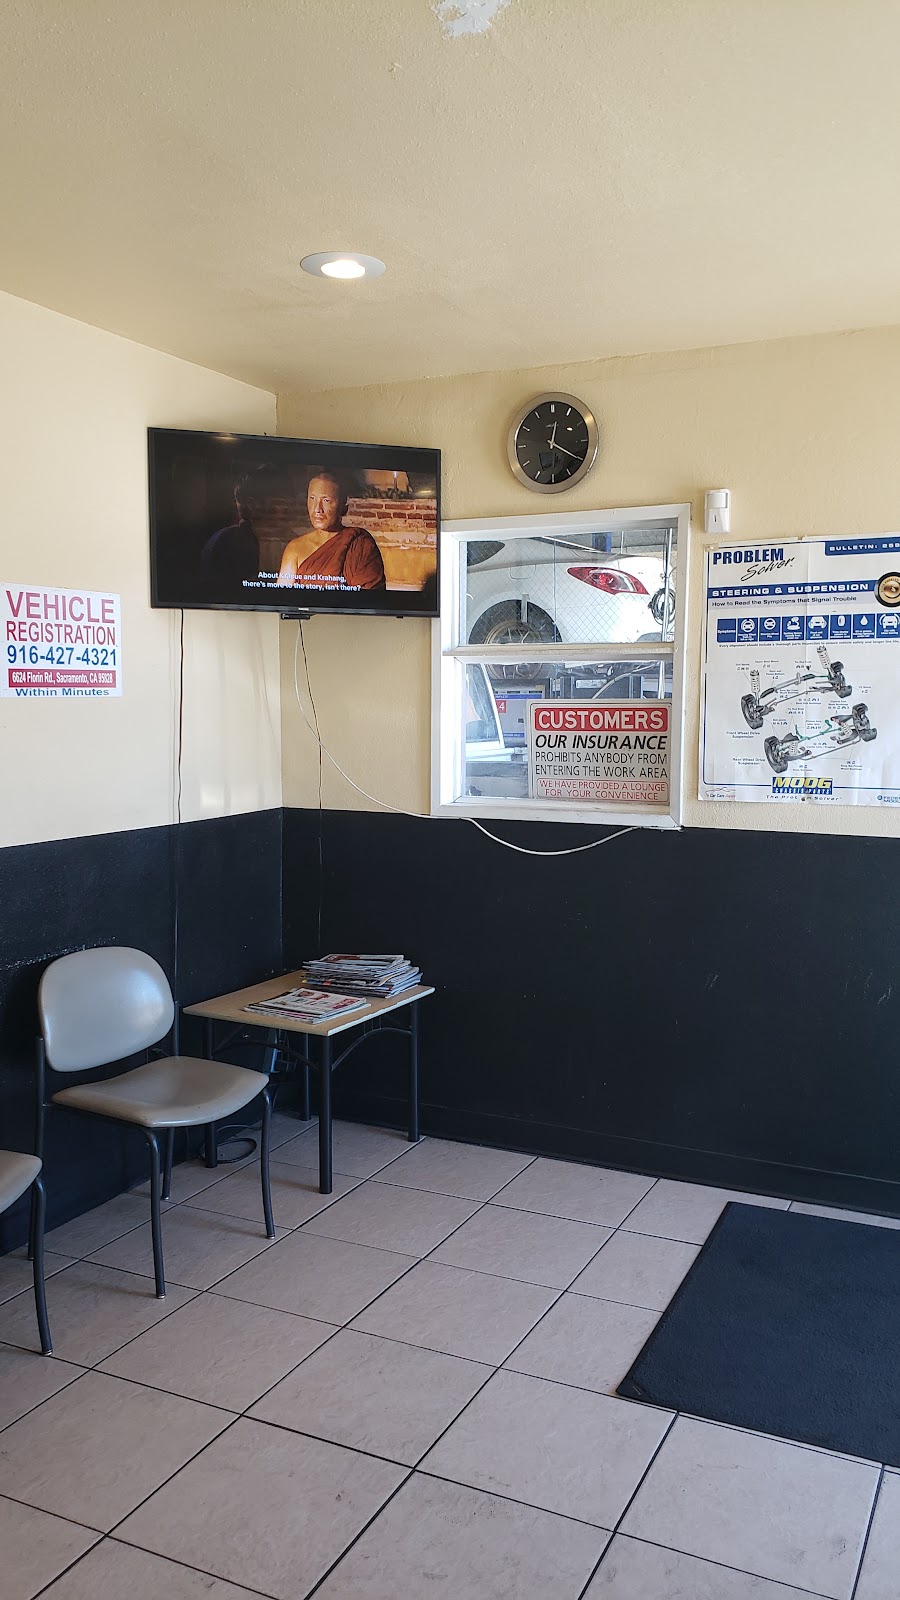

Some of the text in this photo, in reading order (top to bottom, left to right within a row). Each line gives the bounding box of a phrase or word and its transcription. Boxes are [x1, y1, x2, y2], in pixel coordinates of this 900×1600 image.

[712, 548, 784, 565] PROBLEM
[740, 556, 795, 582] Solver
[258, 572, 278, 580] About
[317, 574, 346, 582] Krahang,
[712, 587, 770, 597] STEERING
[788, 583, 869, 593] SUSPENSION
[6, 590, 115, 624] VEHICLE
[763, 598, 795, 606] Symptoms
[6, 620, 116, 646] REGISTRATION
[7, 644, 116, 666] 916-427-4321
[12, 671, 113, 685] 6624 Florin Rd., Sacramento, CA 95828
[16, 688, 110, 696] Within Minutes
[538, 710, 664, 729] CUSTOMERS
[535, 734, 668, 750] OUR INSURANCE
[535, 751, 668, 765] PROHIBITS ANYBODY FROM
[535, 765, 668, 778] ENTERING THE WORK AREA
[540, 780, 553, 789] WE
[554, 781, 577, 789] HAVE
[578, 781, 620, 790] PROVIDED
[630, 783, 665, 792] LOUNGE
[774, 778, 832, 788] MOOG
[567, 790, 591, 798] YOUR
[595, 790, 659, 800] CONVENIENCE
